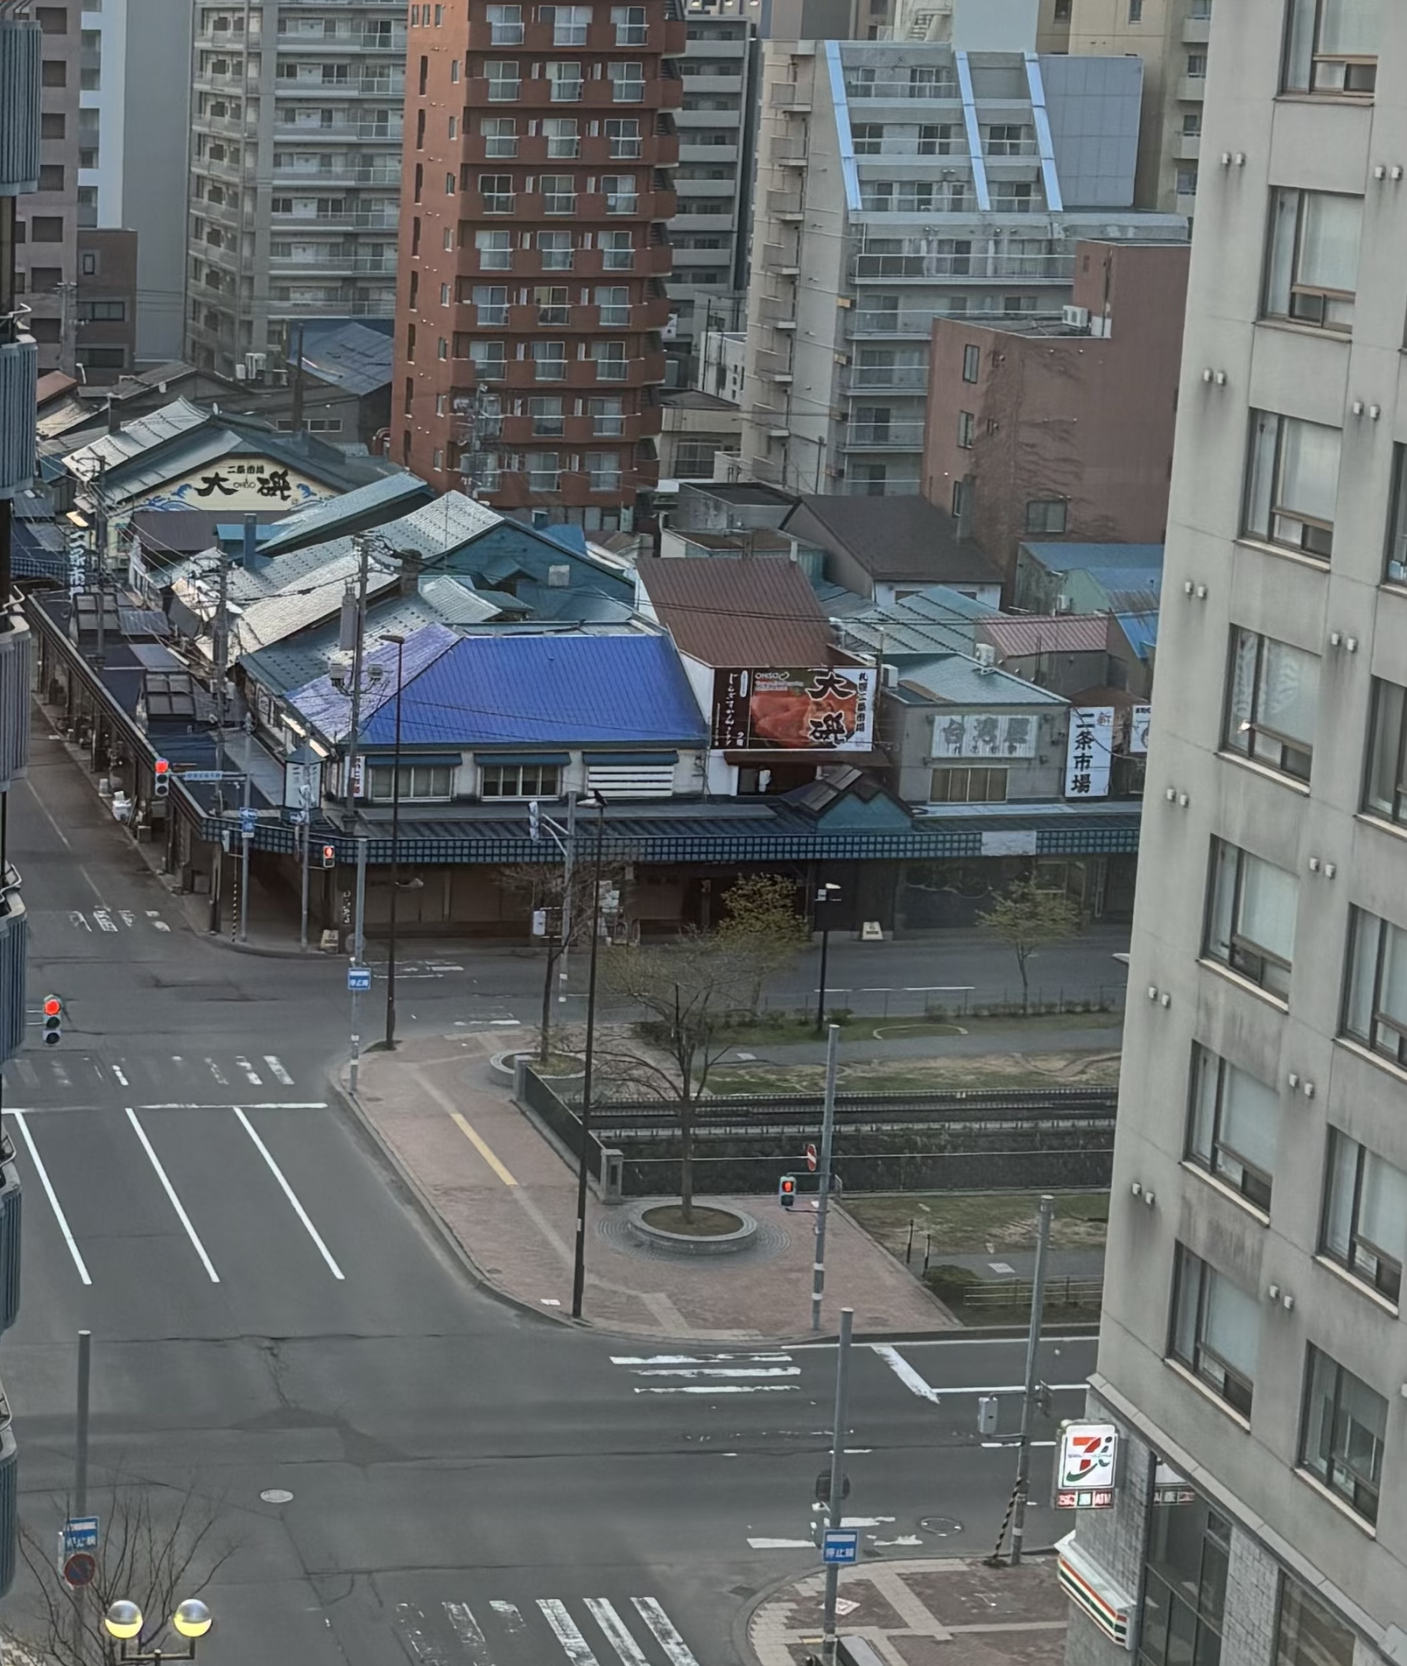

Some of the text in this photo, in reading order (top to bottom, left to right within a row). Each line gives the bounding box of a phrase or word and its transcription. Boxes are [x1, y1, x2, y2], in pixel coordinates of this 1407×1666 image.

[194, 471, 239, 497] 大
[257, 469, 291, 501] 磯
[1071, 712, 1095, 794] 二条市場
